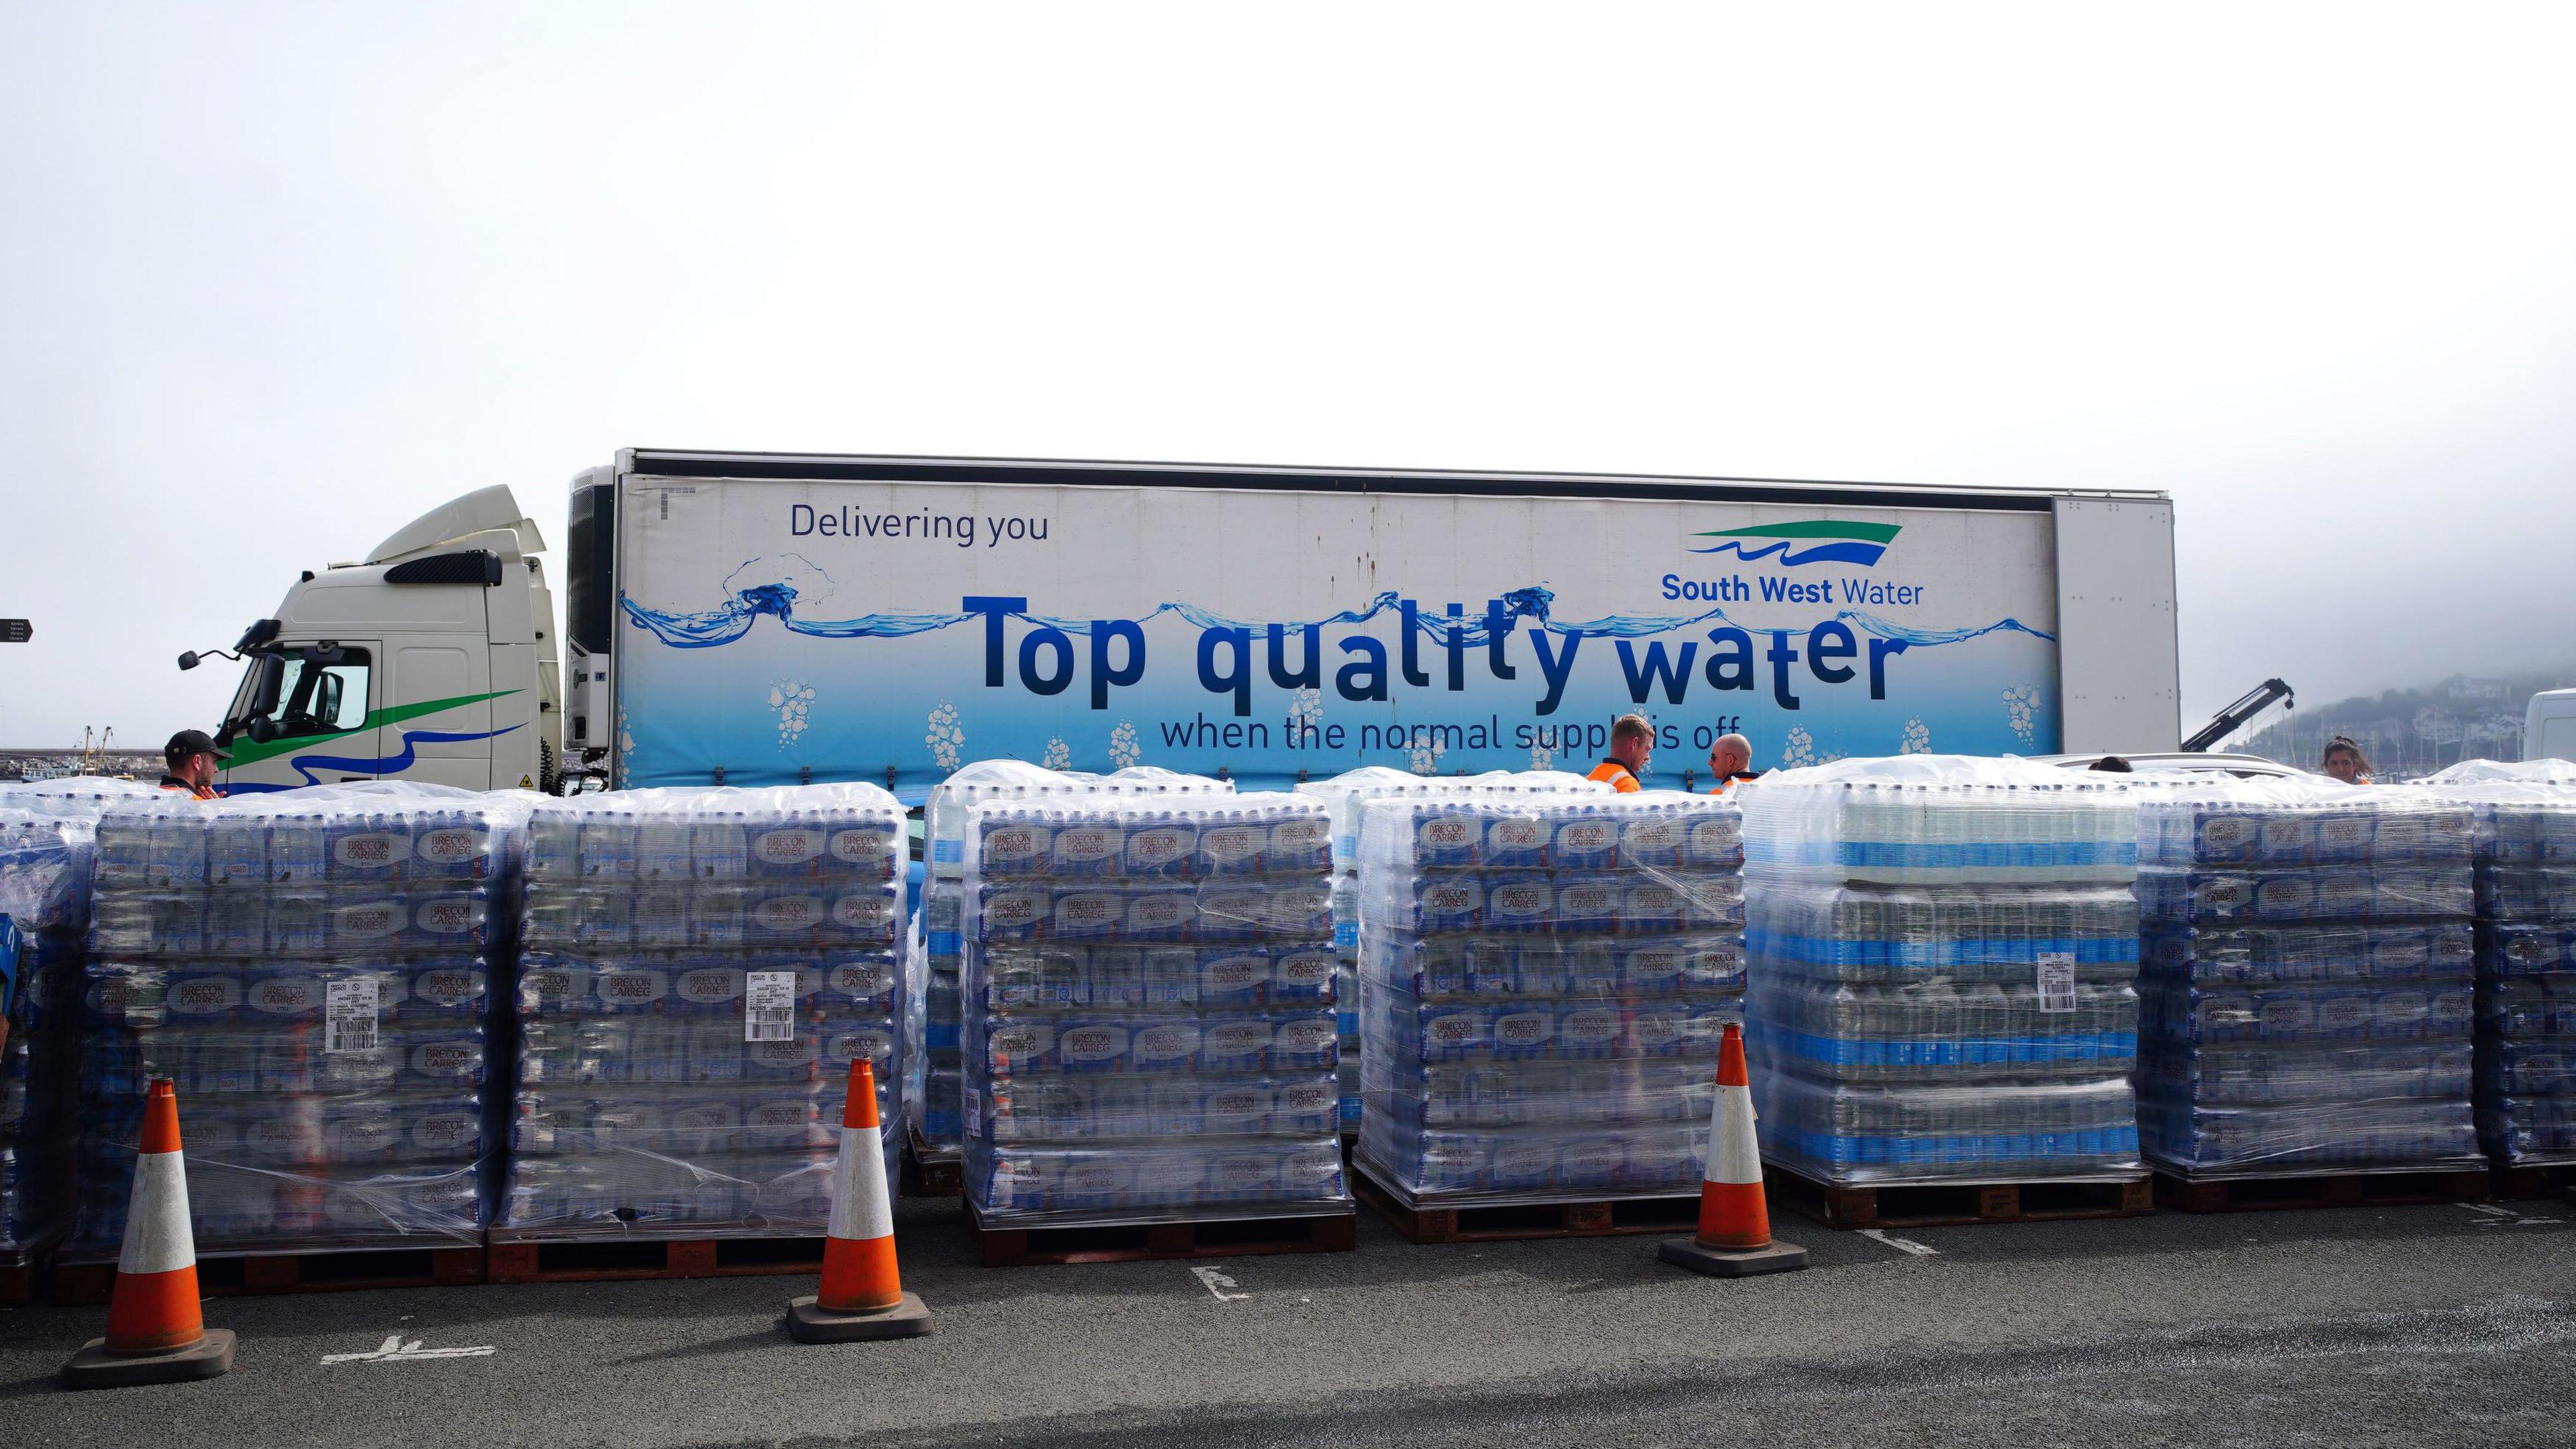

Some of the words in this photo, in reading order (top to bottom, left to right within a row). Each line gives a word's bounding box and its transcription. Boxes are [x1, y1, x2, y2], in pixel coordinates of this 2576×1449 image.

[792, 504, 975, 547] Delivering
[988, 515, 1049, 548] you
[1662, 574, 1750, 602] South
[1759, 576, 1833, 603] West
[1841, 578, 1924, 605] Water
[963, 596, 1146, 710] Top
[1196, 598, 1582, 717] quality
[1614, 620, 1909, 710] water
[1161, 712, 1268, 749] when
[1284, 714, 1345, 750] the
[1361, 713, 1501, 751] normal
[1653, 714, 1680, 749] is
[1429, 824, 1466, 834] BRECON
[1500, 826, 1536, 835] BRECON
[1568, 828, 1604, 837] BRECON
[1701, 826, 1732, 835] BRECON
[431, 836, 472, 845] BRECON
[767, 836, 806, 845] BRECON
[994, 834, 1030, 843] BRECON
[1066, 835, 1104, 844] BRECON
[1139, 837, 1177, 846] BRECON
[1212, 835, 1248, 844] BRECON
[1429, 833, 1466, 843] CARREG
[1500, 835, 1536, 843] CARREG
[1568, 837, 1604, 845] CARREG
[347, 841, 389, 850] BRECON
[431, 845, 472, 855] CARREG
[767, 845, 805, 855] CARREG
[994, 843, 1030, 852] CARREG
[1066, 843, 1103, 853] CARREG
[347, 850, 388, 859] CARREG
[1139, 846, 1177, 855] CARREG
[1432, 889, 1468, 898] BRECON
[1502, 890, 1538, 899] BRECON
[1570, 890, 1607, 899] BRECON
[1637, 891, 1672, 900] BRECON
[994, 899, 1031, 908] BRECON
[1067, 900, 1105, 910] BRECON
[1432, 898, 1468, 907] CARREG
[1502, 899, 1538, 908] CARREG
[1570, 899, 1607, 908] CARREG
[770, 904, 808, 913] BRECON
[994, 908, 1030, 918] CARREG
[1067, 910, 1105, 918] CARREG
[1139, 910, 1177, 920] CARREG
[1637, 954, 1673, 963] BRECON
[1705, 953, 1735, 963] BRECON
[1213, 965, 1250, 974] BRECON
[1637, 962, 1673, 971] CARREG
[429, 976, 470, 986] BRECON
[611, 977, 651, 987] BRECON
[690, 975, 731, 985] BRECON
[1213, 973, 1250, 983] CARREG
[181, 985, 225, 995] BRECON
[263, 985, 306, 995] BRECON
[429, 985, 469, 996] CARREG
[610, 987, 651, 997] CARREG
[689, 985, 730, 995] CARREG
[180, 995, 225, 1004] CARREG
[262, 995, 305, 1004] CARREG
[1437, 1020, 1472, 1030] BRECON
[1505, 1020, 1541, 1029] BRECON
[1572, 1017, 1609, 1026] BRECON
[1216, 1030, 1253, 1039] BRECON
[1437, 1030, 1472, 1039] CARREG
[1505, 1028, 1541, 1038] CARREG
[1572, 1026, 1608, 1034] CARREG
[1073, 1033, 1110, 1042] BRECON
[1144, 1033, 1182, 1042] BRECON
[1001, 1042, 1036, 1051] CARREG
[1073, 1043, 1110, 1053] CARREG
[1144, 1042, 1182, 1052] CARREG
[425, 1049, 466, 1058] BRECON
[1289, 1090, 1324, 1099] BRECON
[1217, 1097, 1254, 1106] BRECON
